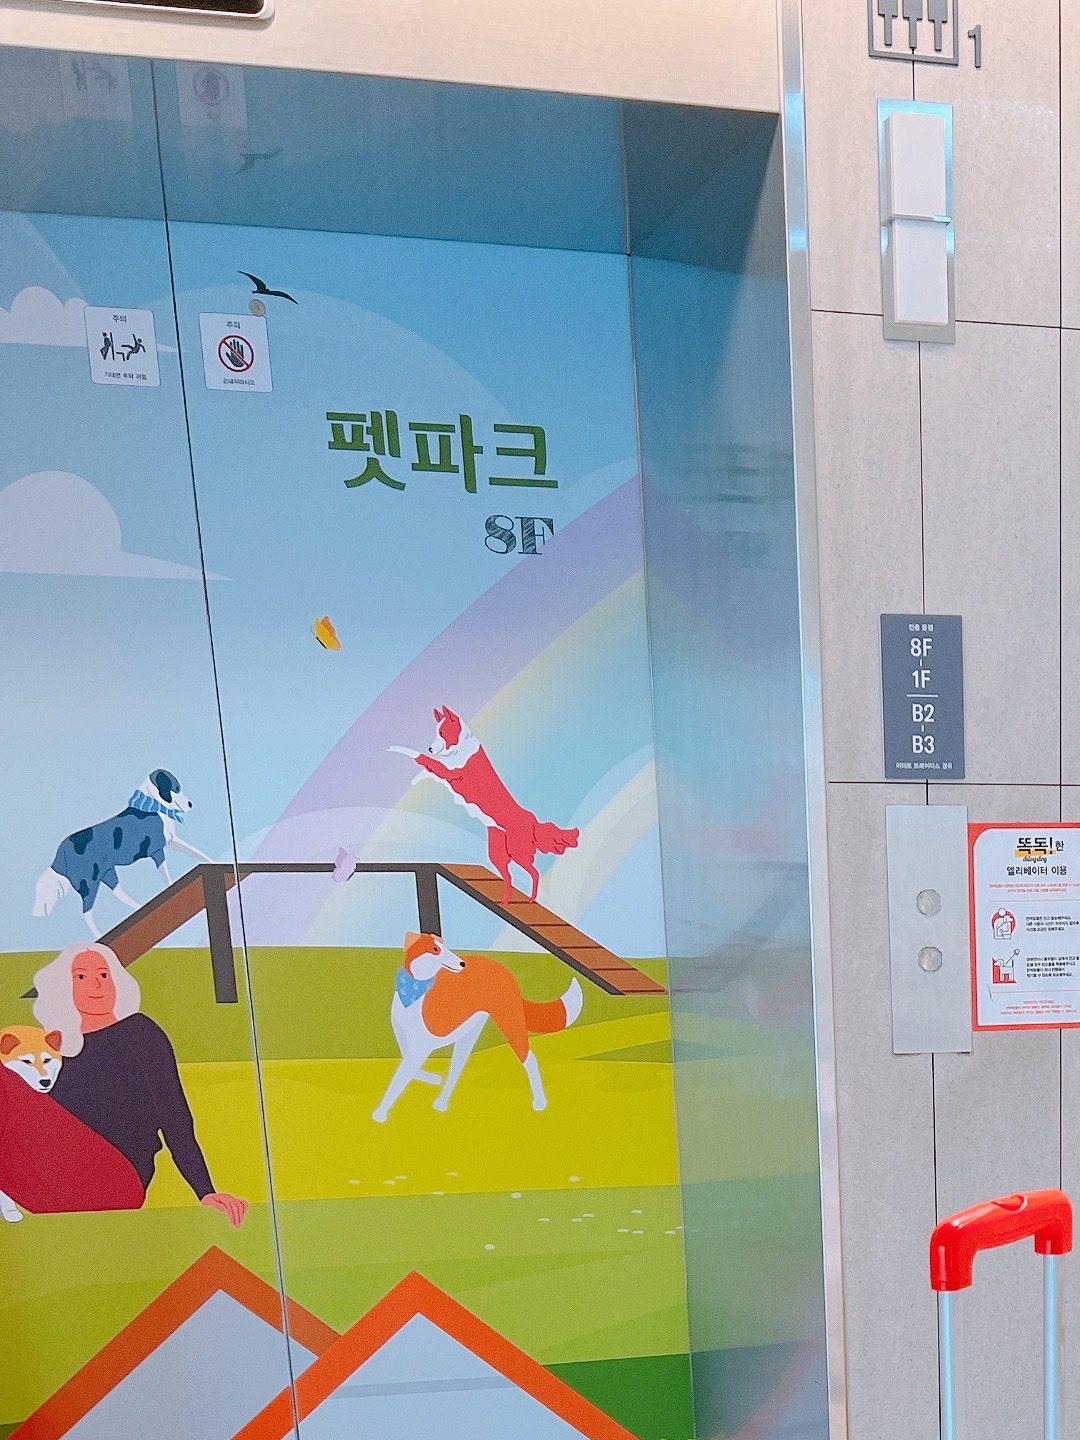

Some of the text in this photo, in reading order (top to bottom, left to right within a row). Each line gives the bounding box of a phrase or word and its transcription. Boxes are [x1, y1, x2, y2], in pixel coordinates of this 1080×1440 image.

[967, 24, 982, 69] 1
[112, 314, 127, 323] 주의
[226, 320, 241, 329] 주의
[326, 409, 559, 494] 펫파크
[484, 514, 555, 556] 8F
[910, 637, 933, 658] 8F
[912, 669, 931, 689] 1F
[912, 703, 935, 723] B2
[912, 734, 935, 755] B3
[1055, 840, 1065, 852] 한
[1006, 865, 1068, 877] 엘리베이터 이용
